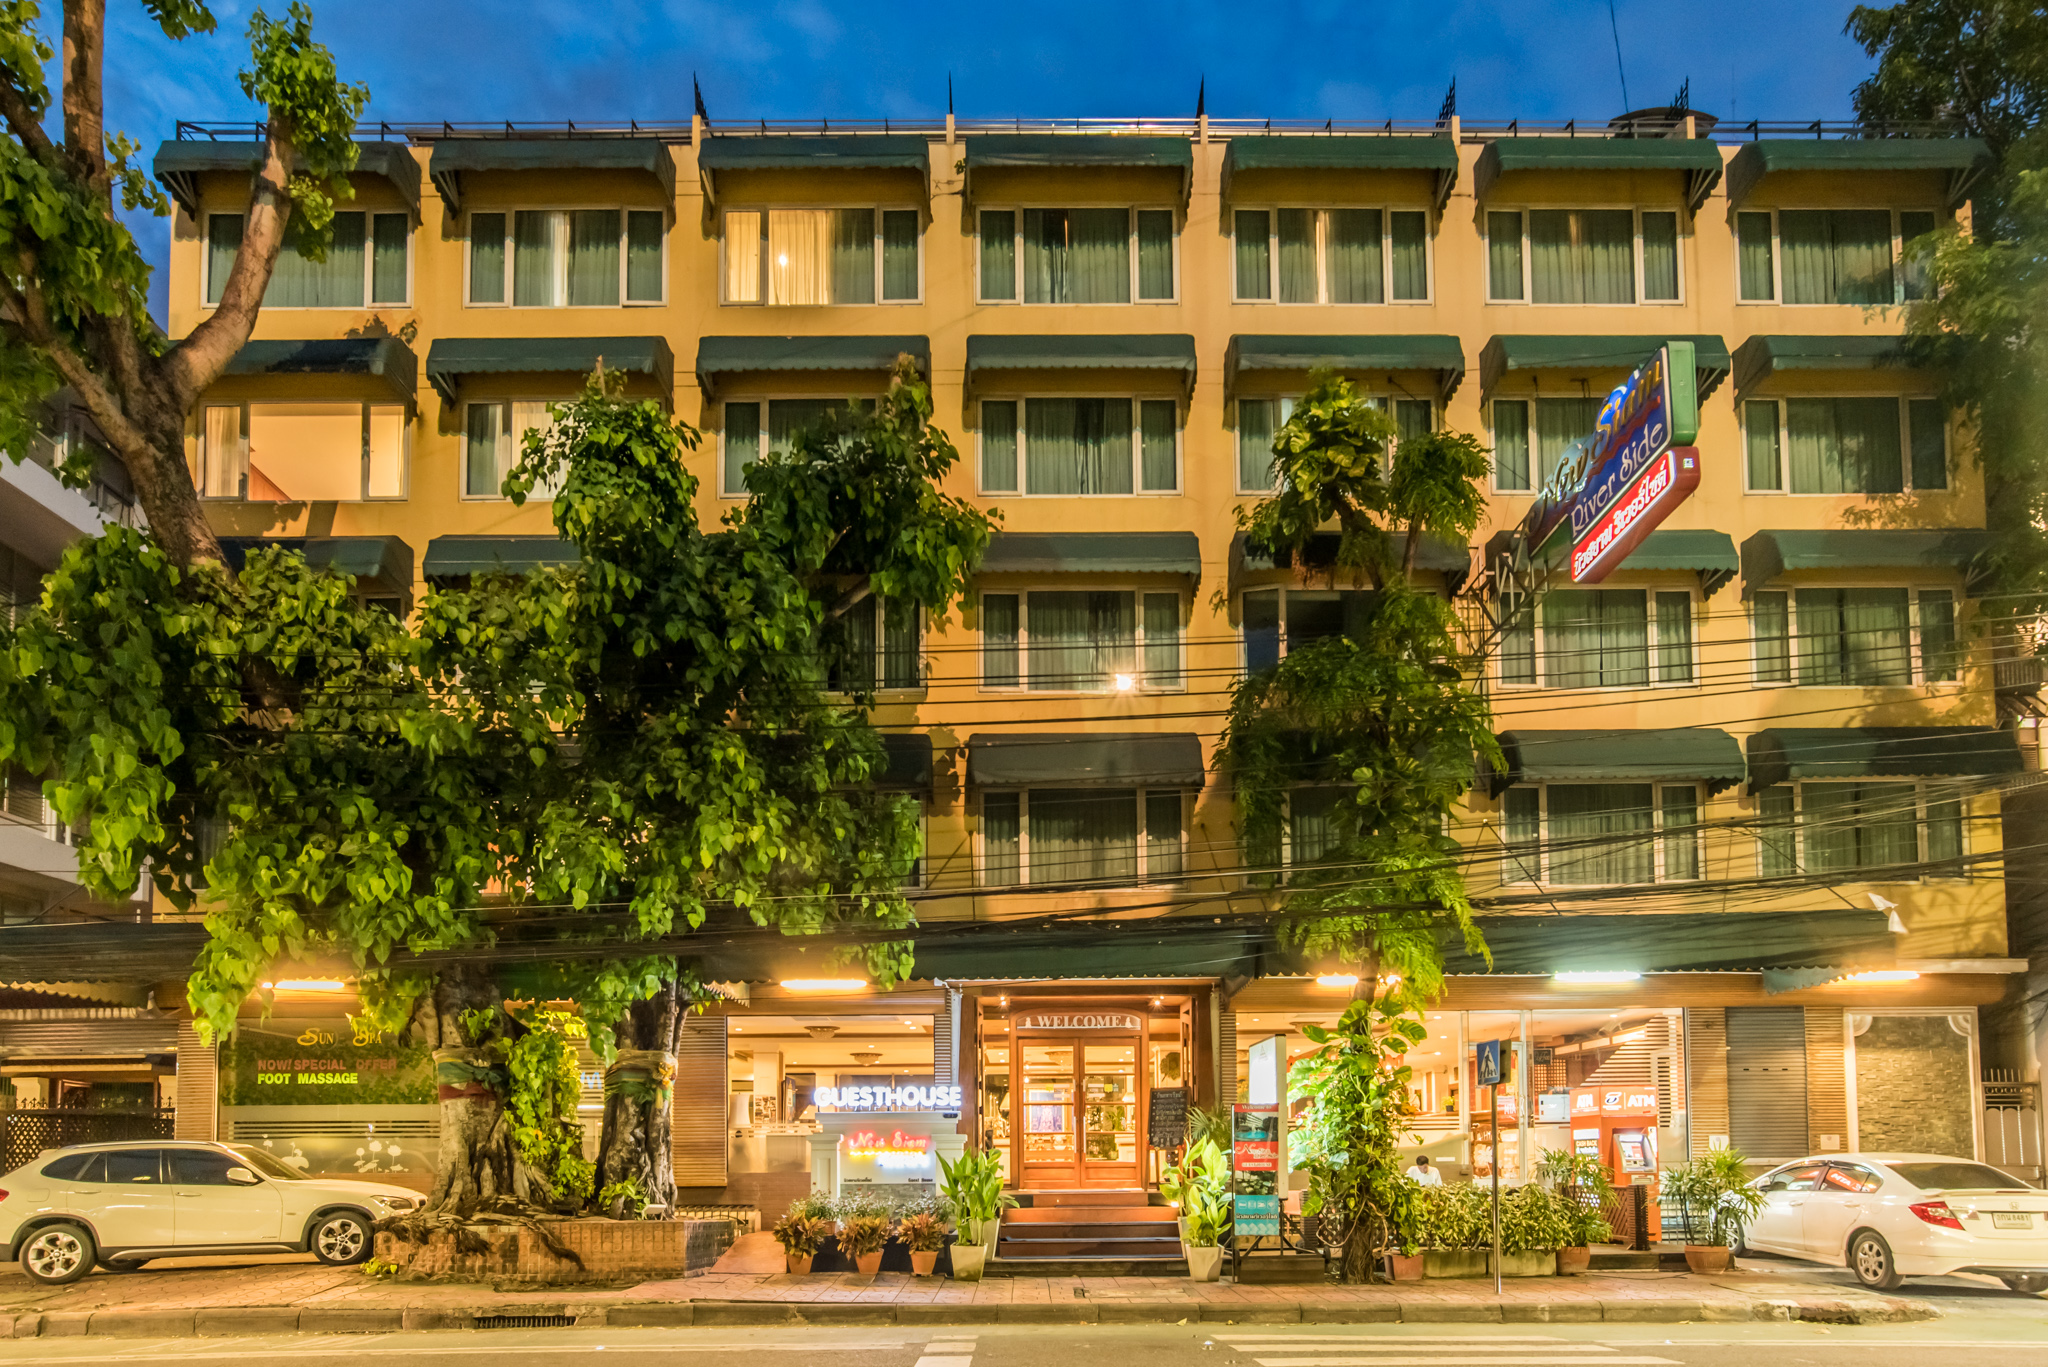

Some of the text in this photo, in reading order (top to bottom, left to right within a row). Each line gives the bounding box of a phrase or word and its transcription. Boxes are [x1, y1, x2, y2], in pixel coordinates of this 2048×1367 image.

[1570, 423, 1663, 538] River Side
[1037, 1015, 1122, 1028] WELCOME
[257, 1058, 397, 1071] NOW! SPECIAL OFFER
[257, 1072, 358, 1085] FOOT MASSAGE
[814, 1086, 962, 1108] GUESTHOUSE
[1577, 1094, 1594, 1108] ATM
[1627, 1094, 1656, 1107] ATM
